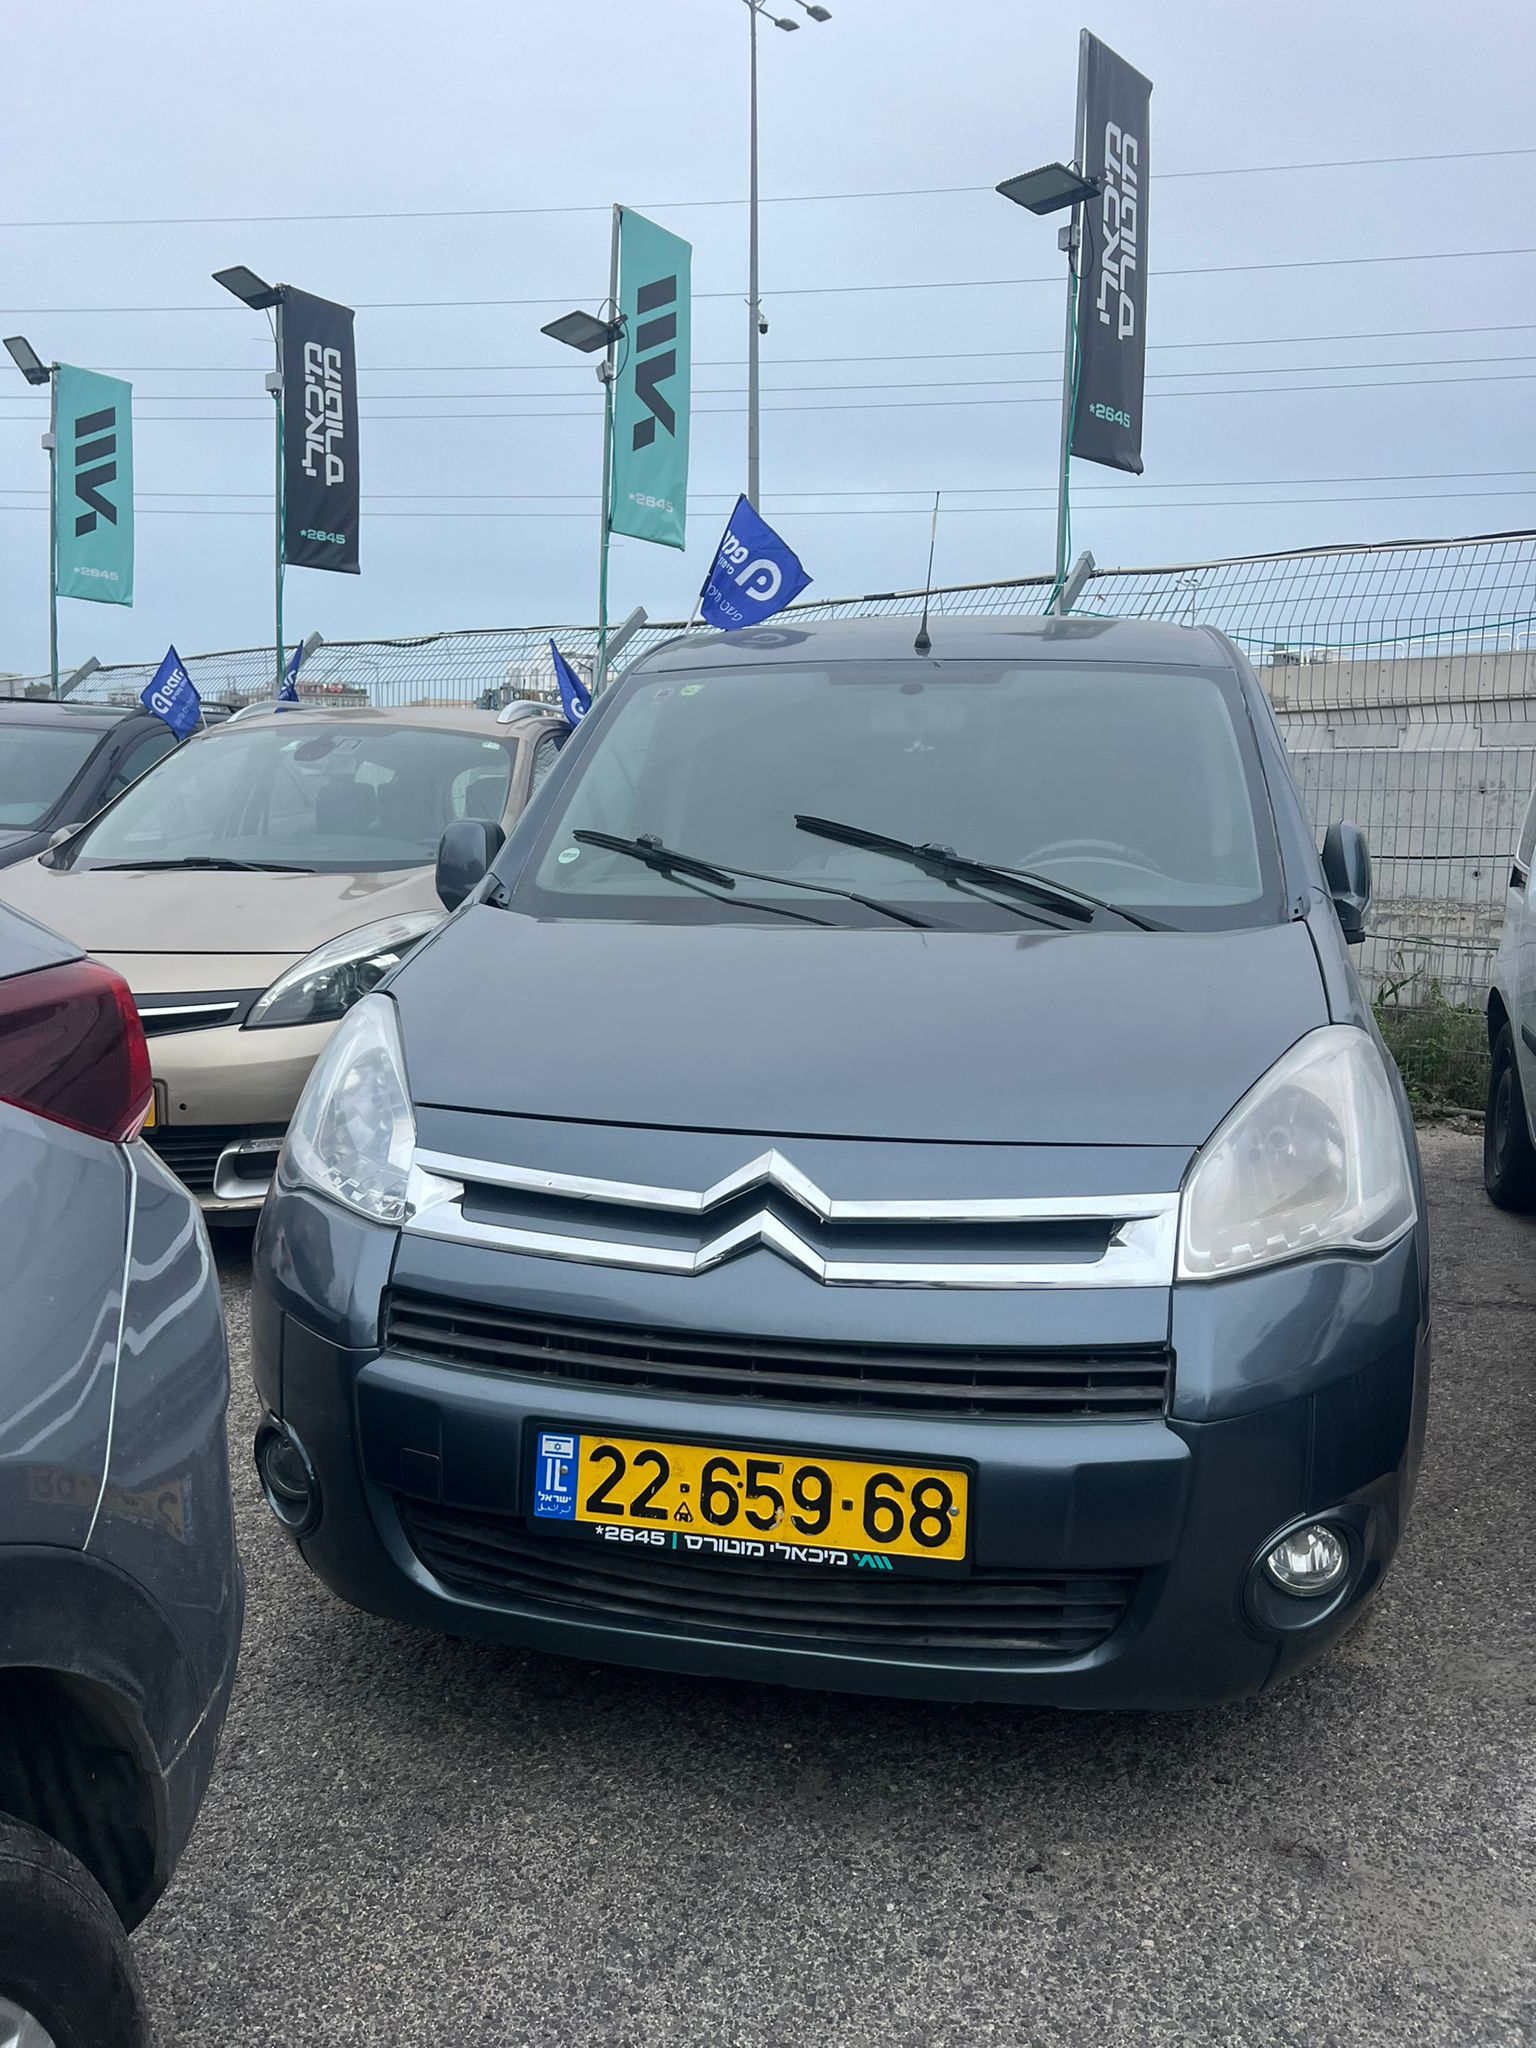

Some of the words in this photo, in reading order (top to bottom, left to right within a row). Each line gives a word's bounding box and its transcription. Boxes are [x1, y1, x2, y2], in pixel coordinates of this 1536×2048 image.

[1118, 132, 1138, 340] מוטורס
[302, 341, 325, 477] מיכאלי
[323, 347, 344, 486] מוטורס
[545, 1458, 568, 1492] IL
[537, 1491, 572, 1504] ישראל
[684, 1534, 765, 1557] מוטורס
[769, 1542, 849, 1566] מיכאלי
